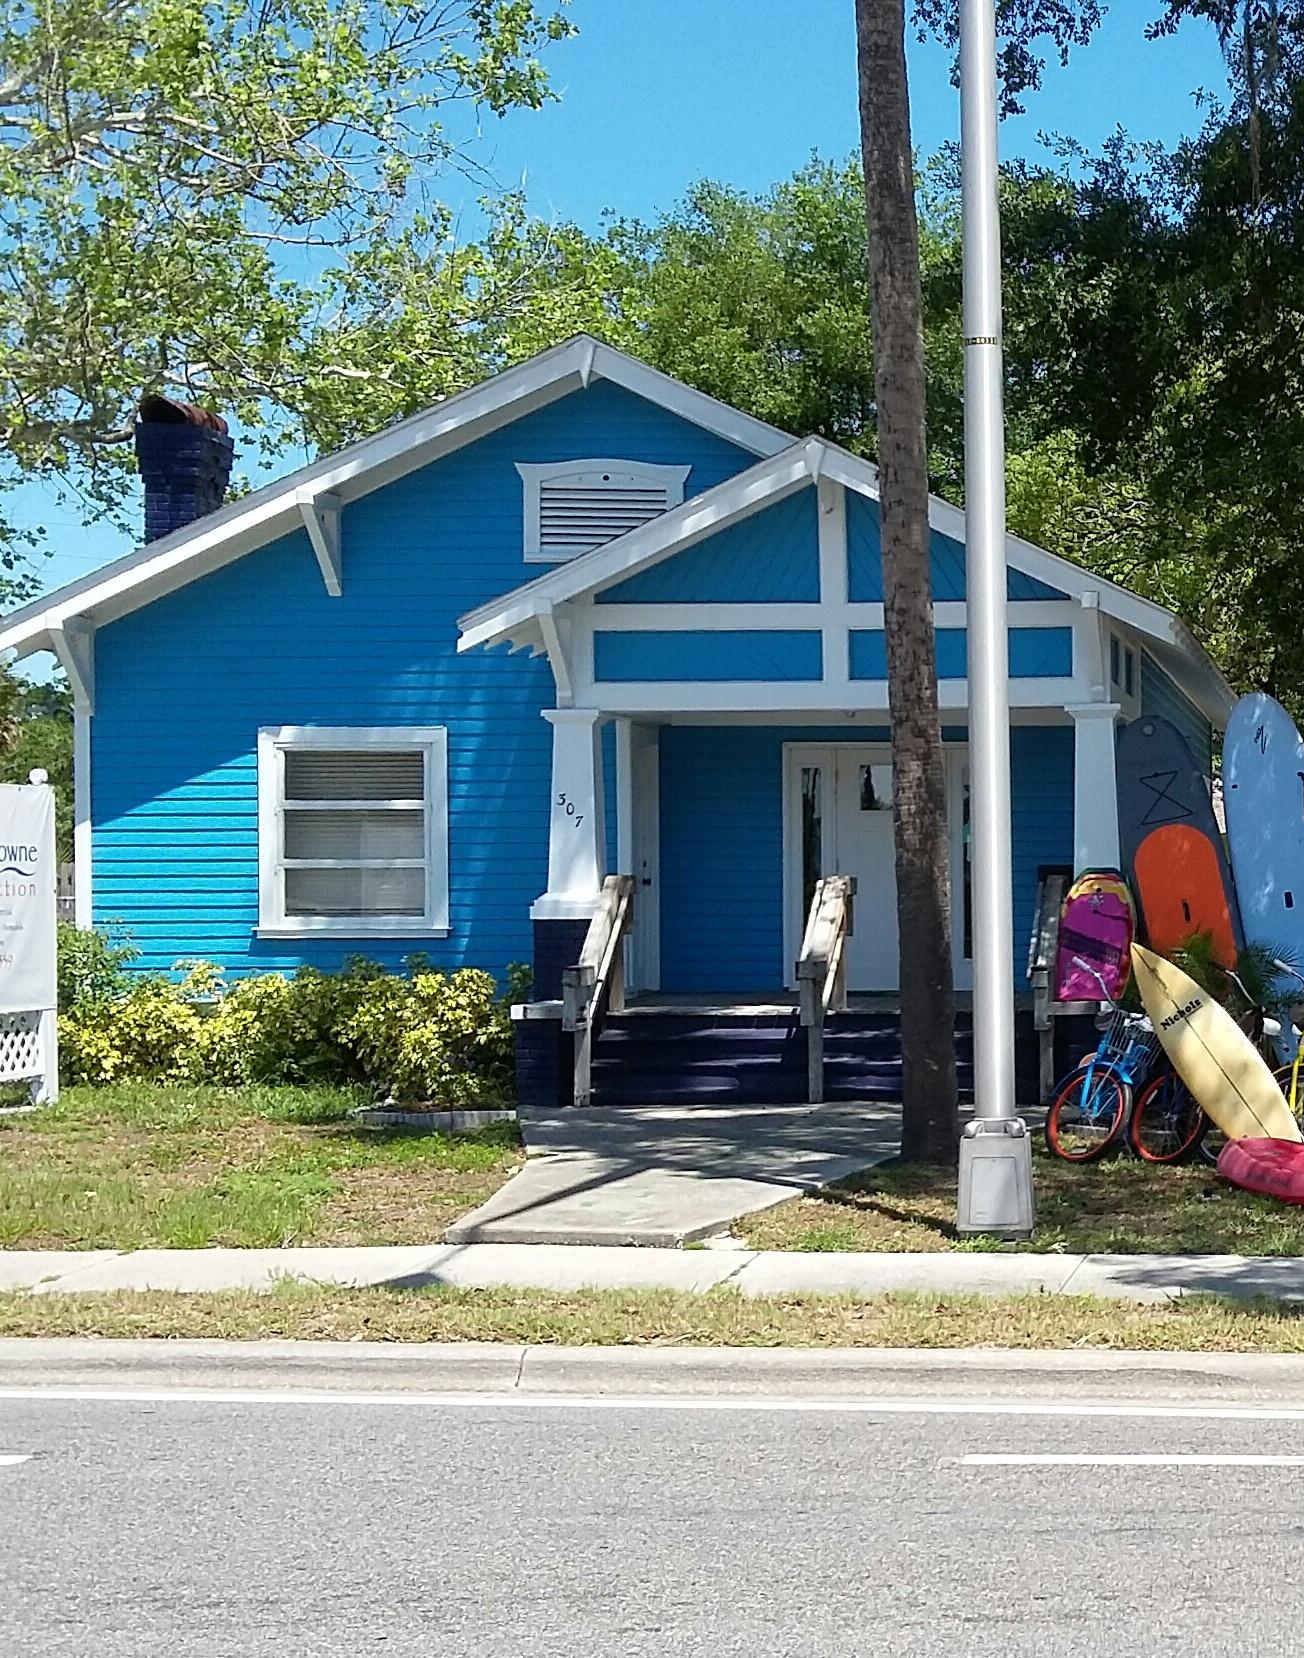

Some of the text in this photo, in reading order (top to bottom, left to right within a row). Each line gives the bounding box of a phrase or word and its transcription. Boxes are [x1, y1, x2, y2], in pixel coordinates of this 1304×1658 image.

[556, 793, 584, 828] 307
[0, 879, 36, 897] tion
[1160, 999, 1202, 1030] Nichols
